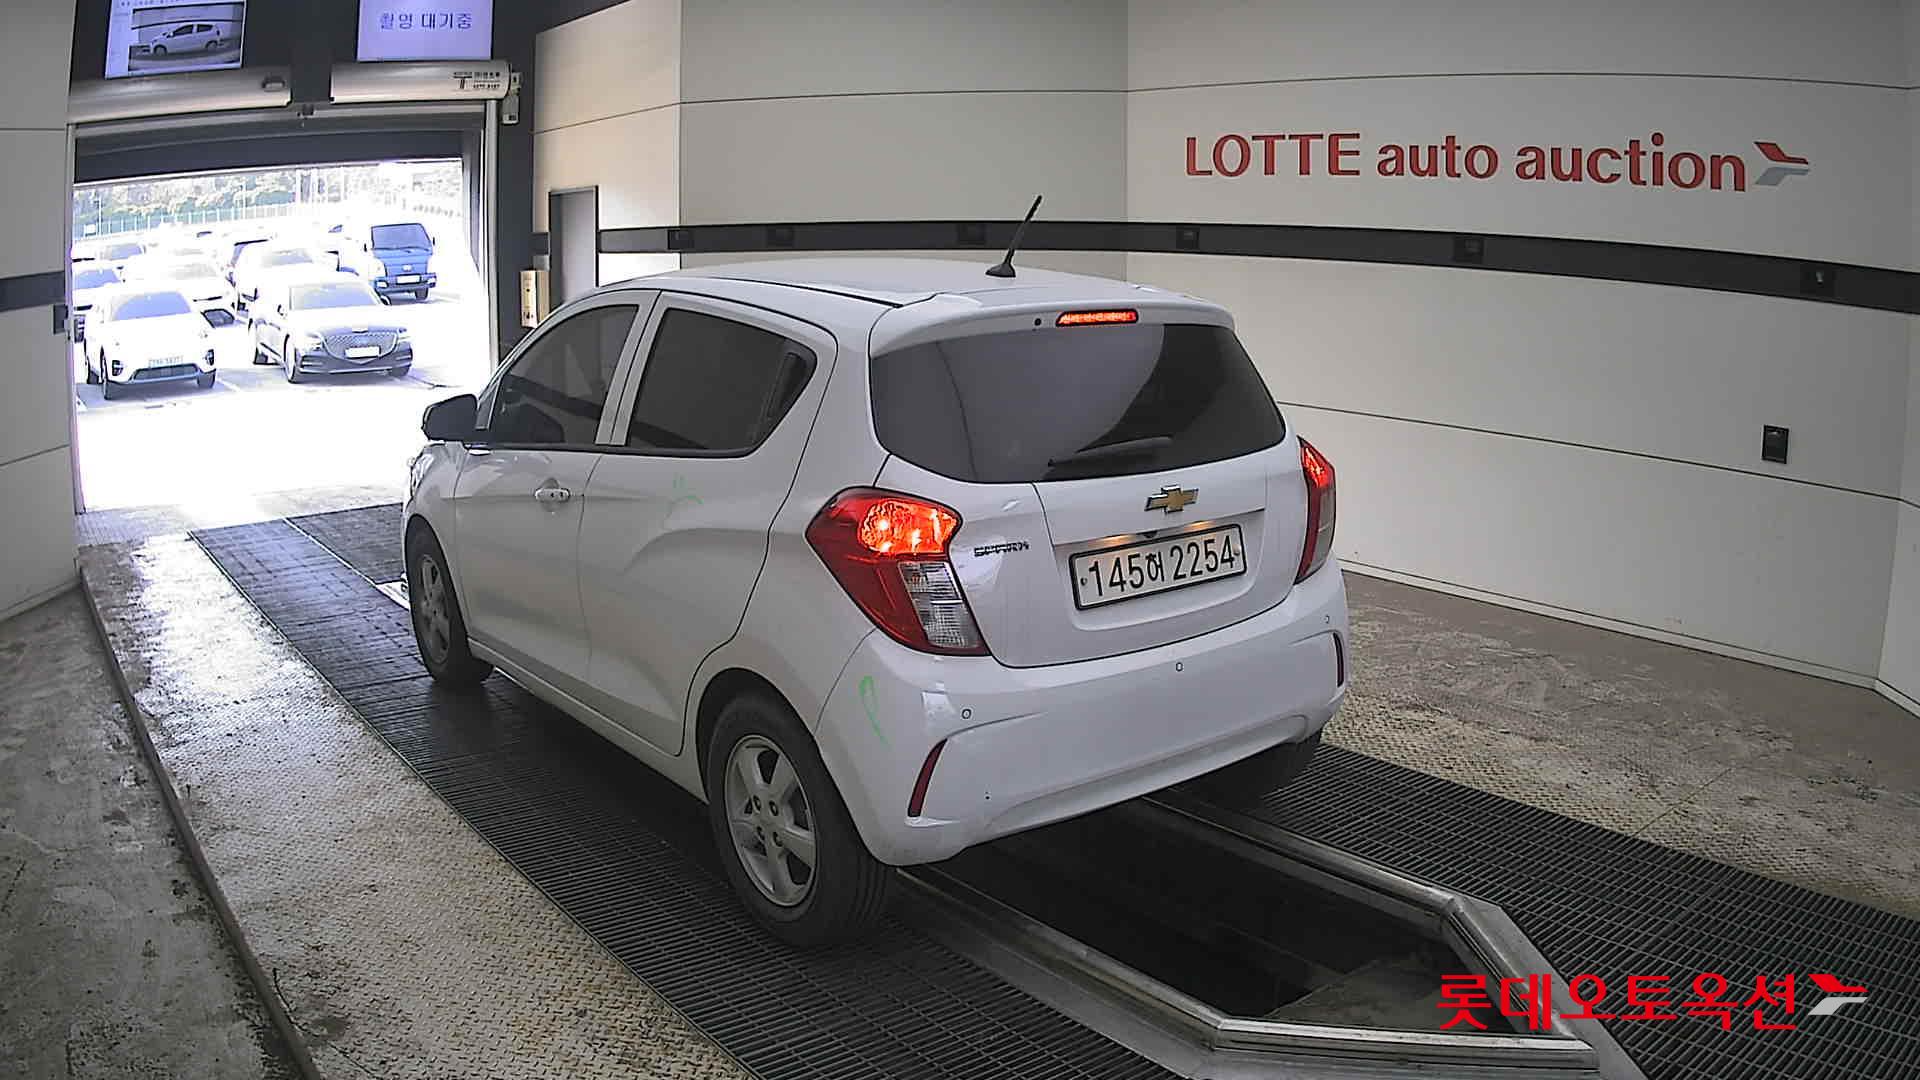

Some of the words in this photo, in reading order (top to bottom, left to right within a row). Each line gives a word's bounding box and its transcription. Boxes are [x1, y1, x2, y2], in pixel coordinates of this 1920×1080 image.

[421, 12, 473, 30] 대기중
[1186, 132, 1361, 177] LOTTE
[1376, 135, 1499, 179] auto
[1516, 132, 1747, 192] auction
[1088, 550, 1166, 598] 145허
[1170, 534, 1236, 582] 2254
